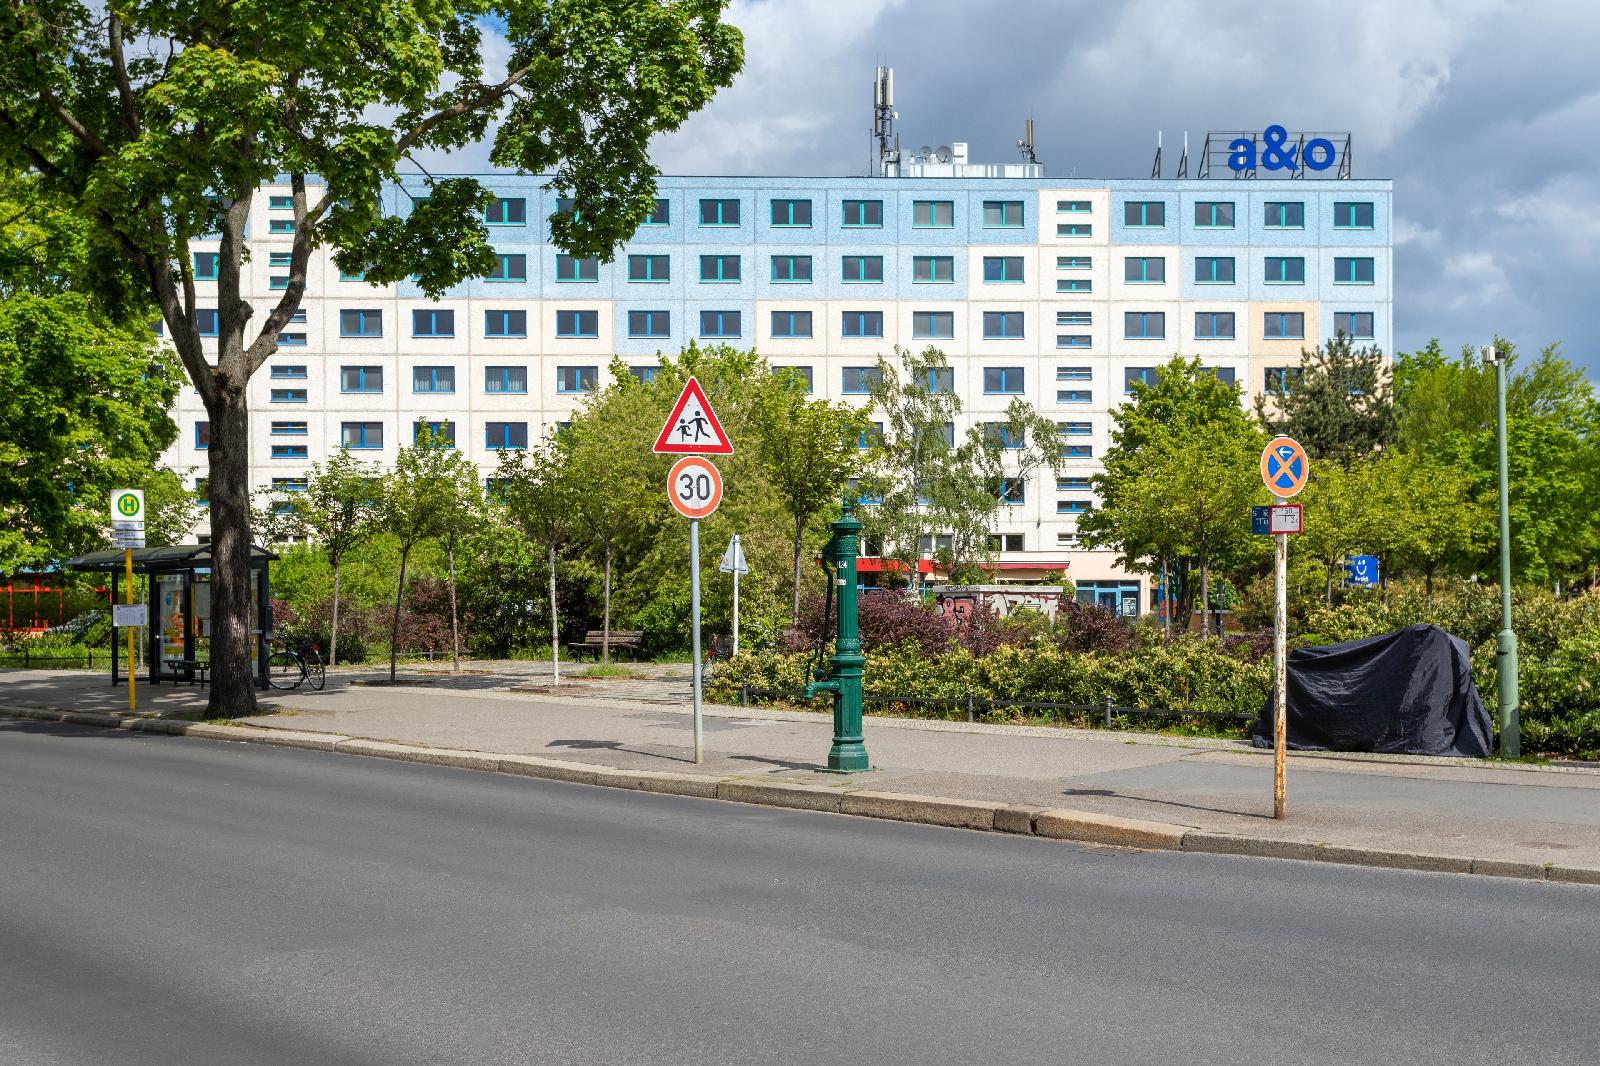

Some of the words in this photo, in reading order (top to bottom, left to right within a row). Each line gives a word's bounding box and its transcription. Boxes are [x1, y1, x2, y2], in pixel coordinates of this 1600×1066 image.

[1228, 125, 1336, 171] a&o
[679, 474, 711, 501] 30
[123, 498, 134, 511] H
